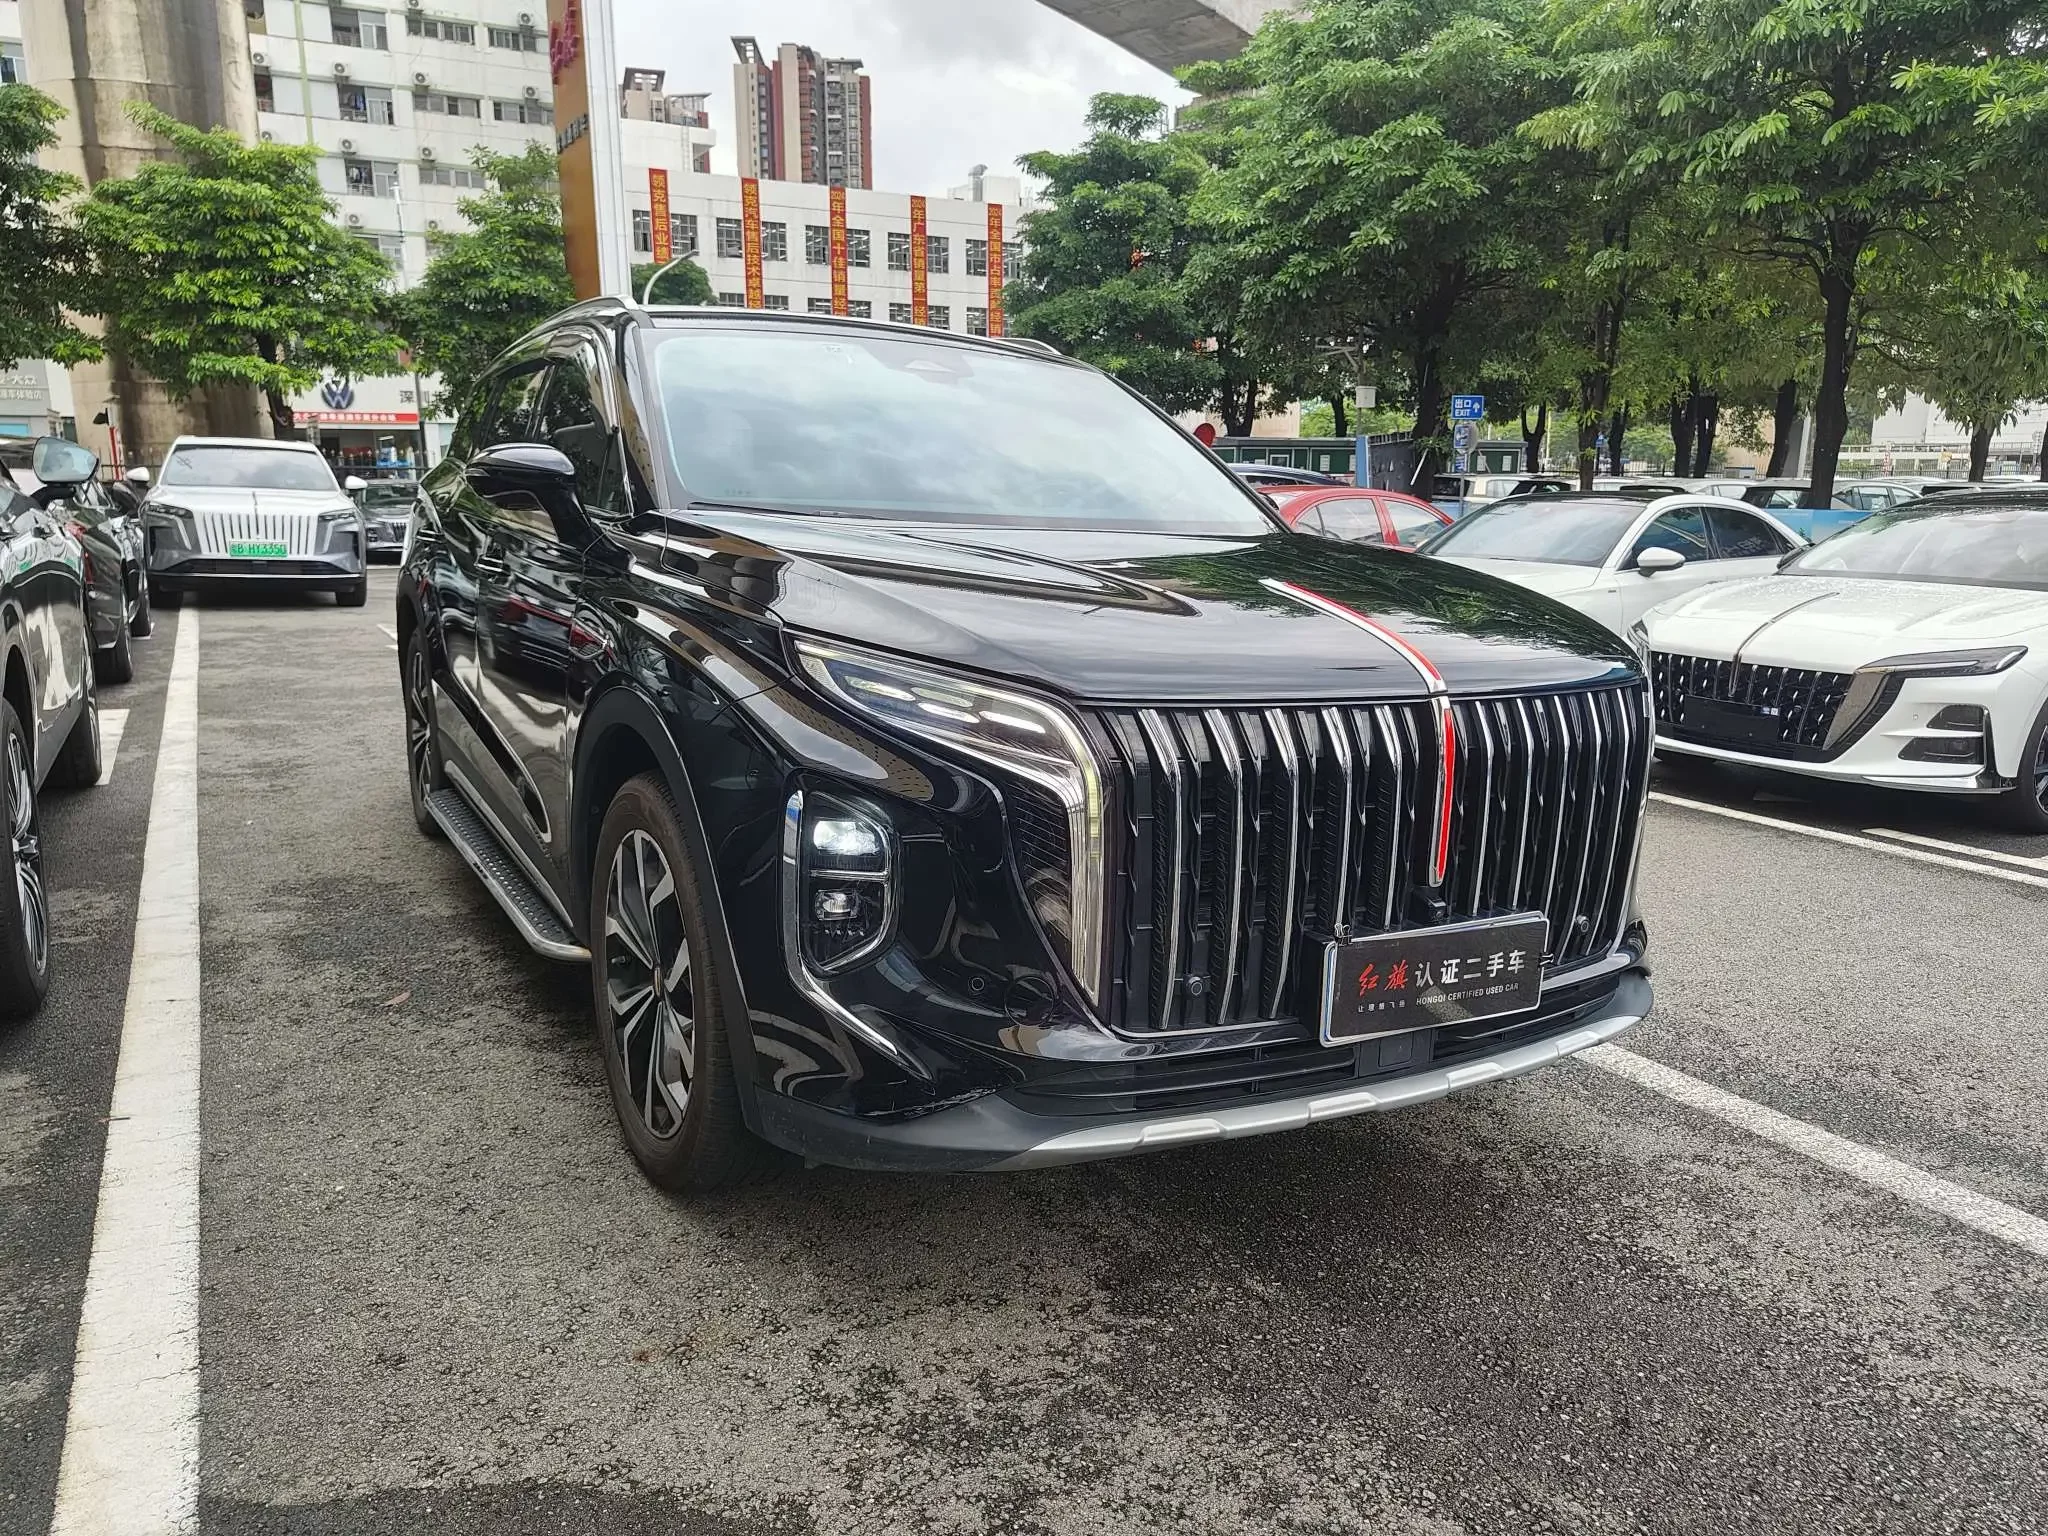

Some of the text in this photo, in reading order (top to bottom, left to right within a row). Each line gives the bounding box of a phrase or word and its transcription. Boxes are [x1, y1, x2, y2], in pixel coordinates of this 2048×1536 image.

[1455, 399, 1471, 408] 出口
[1455, 409, 1471, 417] EXIT
[1416, 982, 1519, 1006] HONGQI CERTIFIED USED CAR
